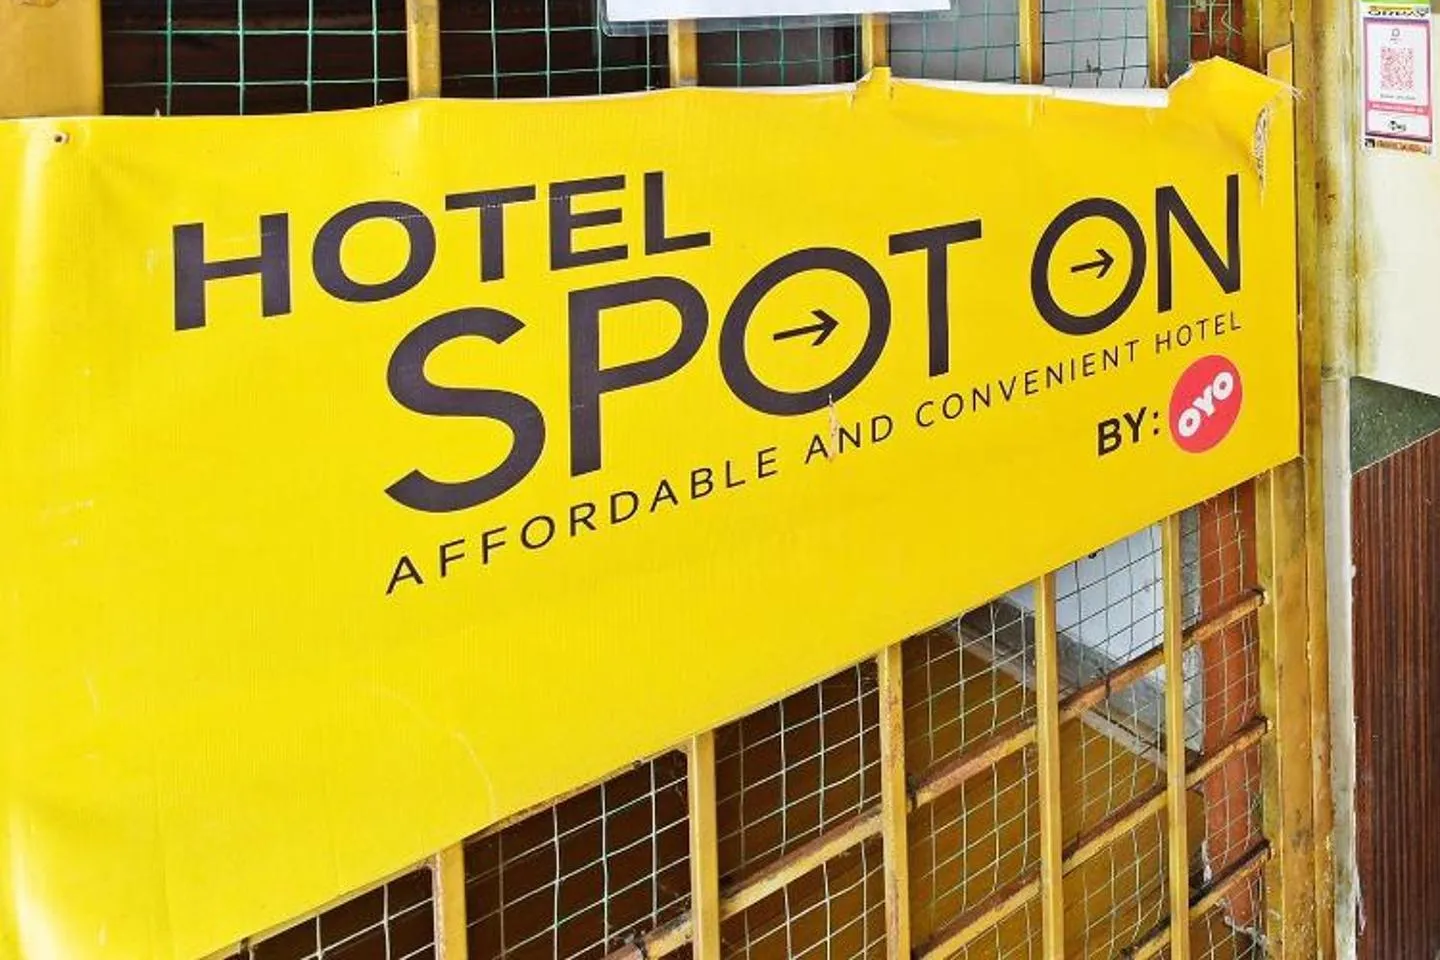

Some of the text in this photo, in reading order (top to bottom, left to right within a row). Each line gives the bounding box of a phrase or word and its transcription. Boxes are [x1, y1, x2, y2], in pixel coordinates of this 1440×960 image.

[171, 169, 713, 332] HOTEL
[383, 172, 1243, 514] SPOT ON
[386, 310, 1243, 595] AFFORDABLE AND CONVENIENT HOTEL
[1094, 370, 1235, 457] BY: OYO
